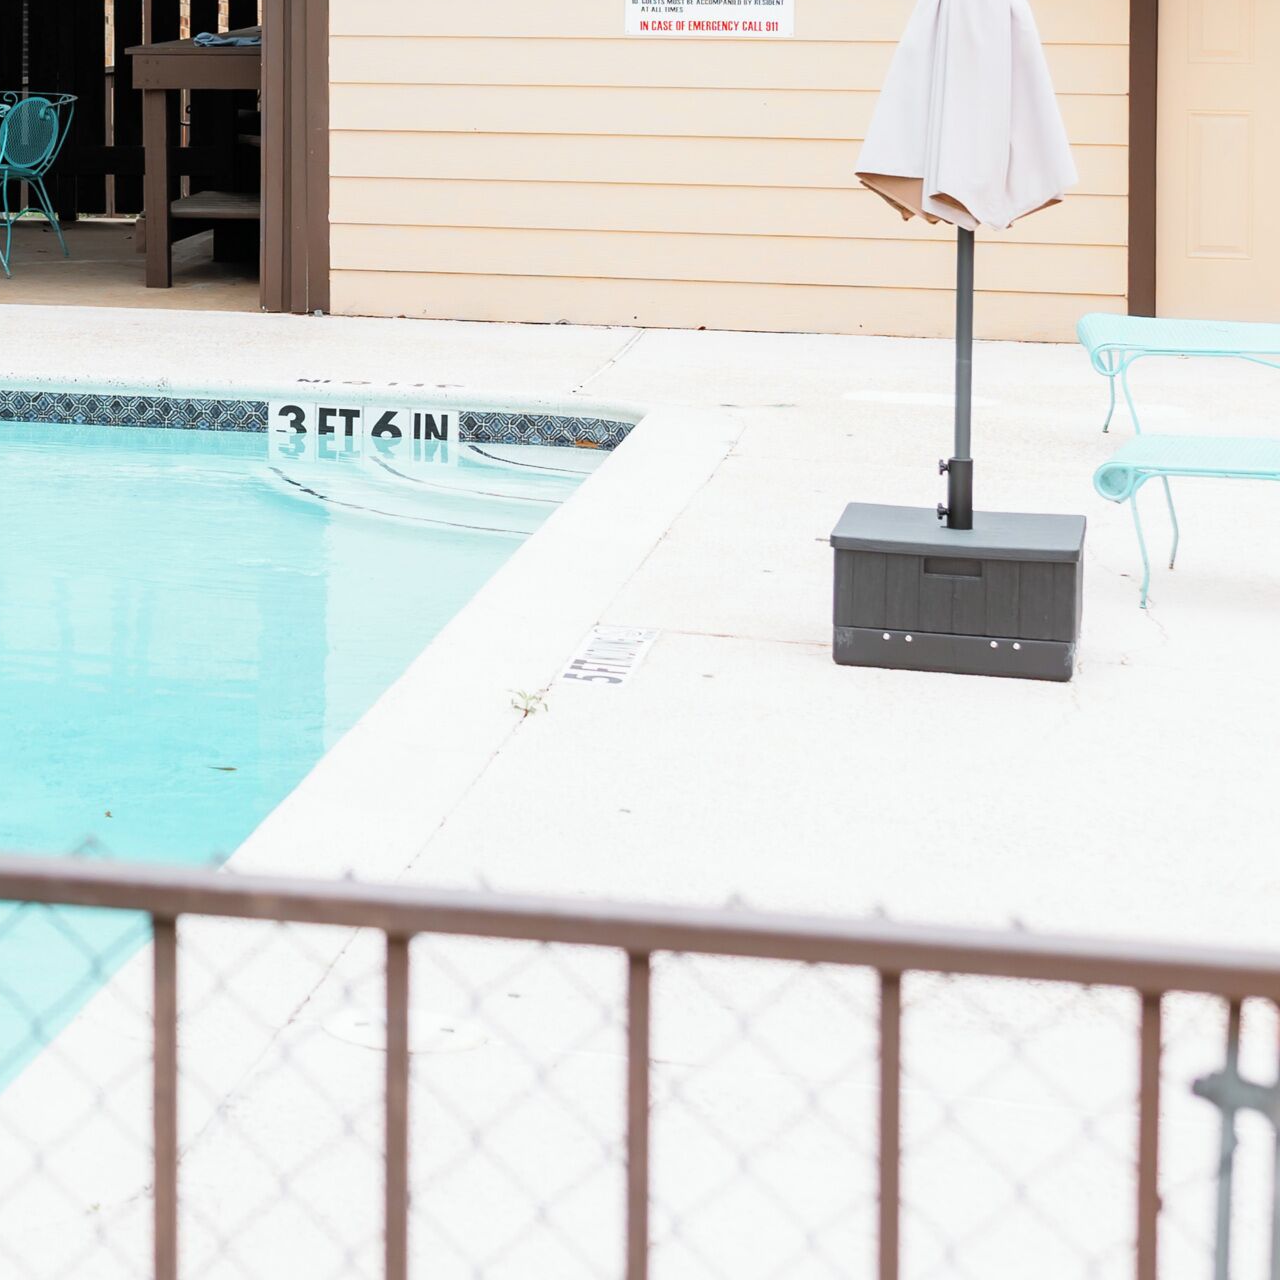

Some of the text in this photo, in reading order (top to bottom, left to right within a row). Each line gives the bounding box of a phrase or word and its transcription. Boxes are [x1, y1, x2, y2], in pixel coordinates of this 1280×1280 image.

[640, 20, 779, 31] IN CASE OF EMERGENCY CALL 911
[276, 404, 448, 440] 3 FT 6 IN
